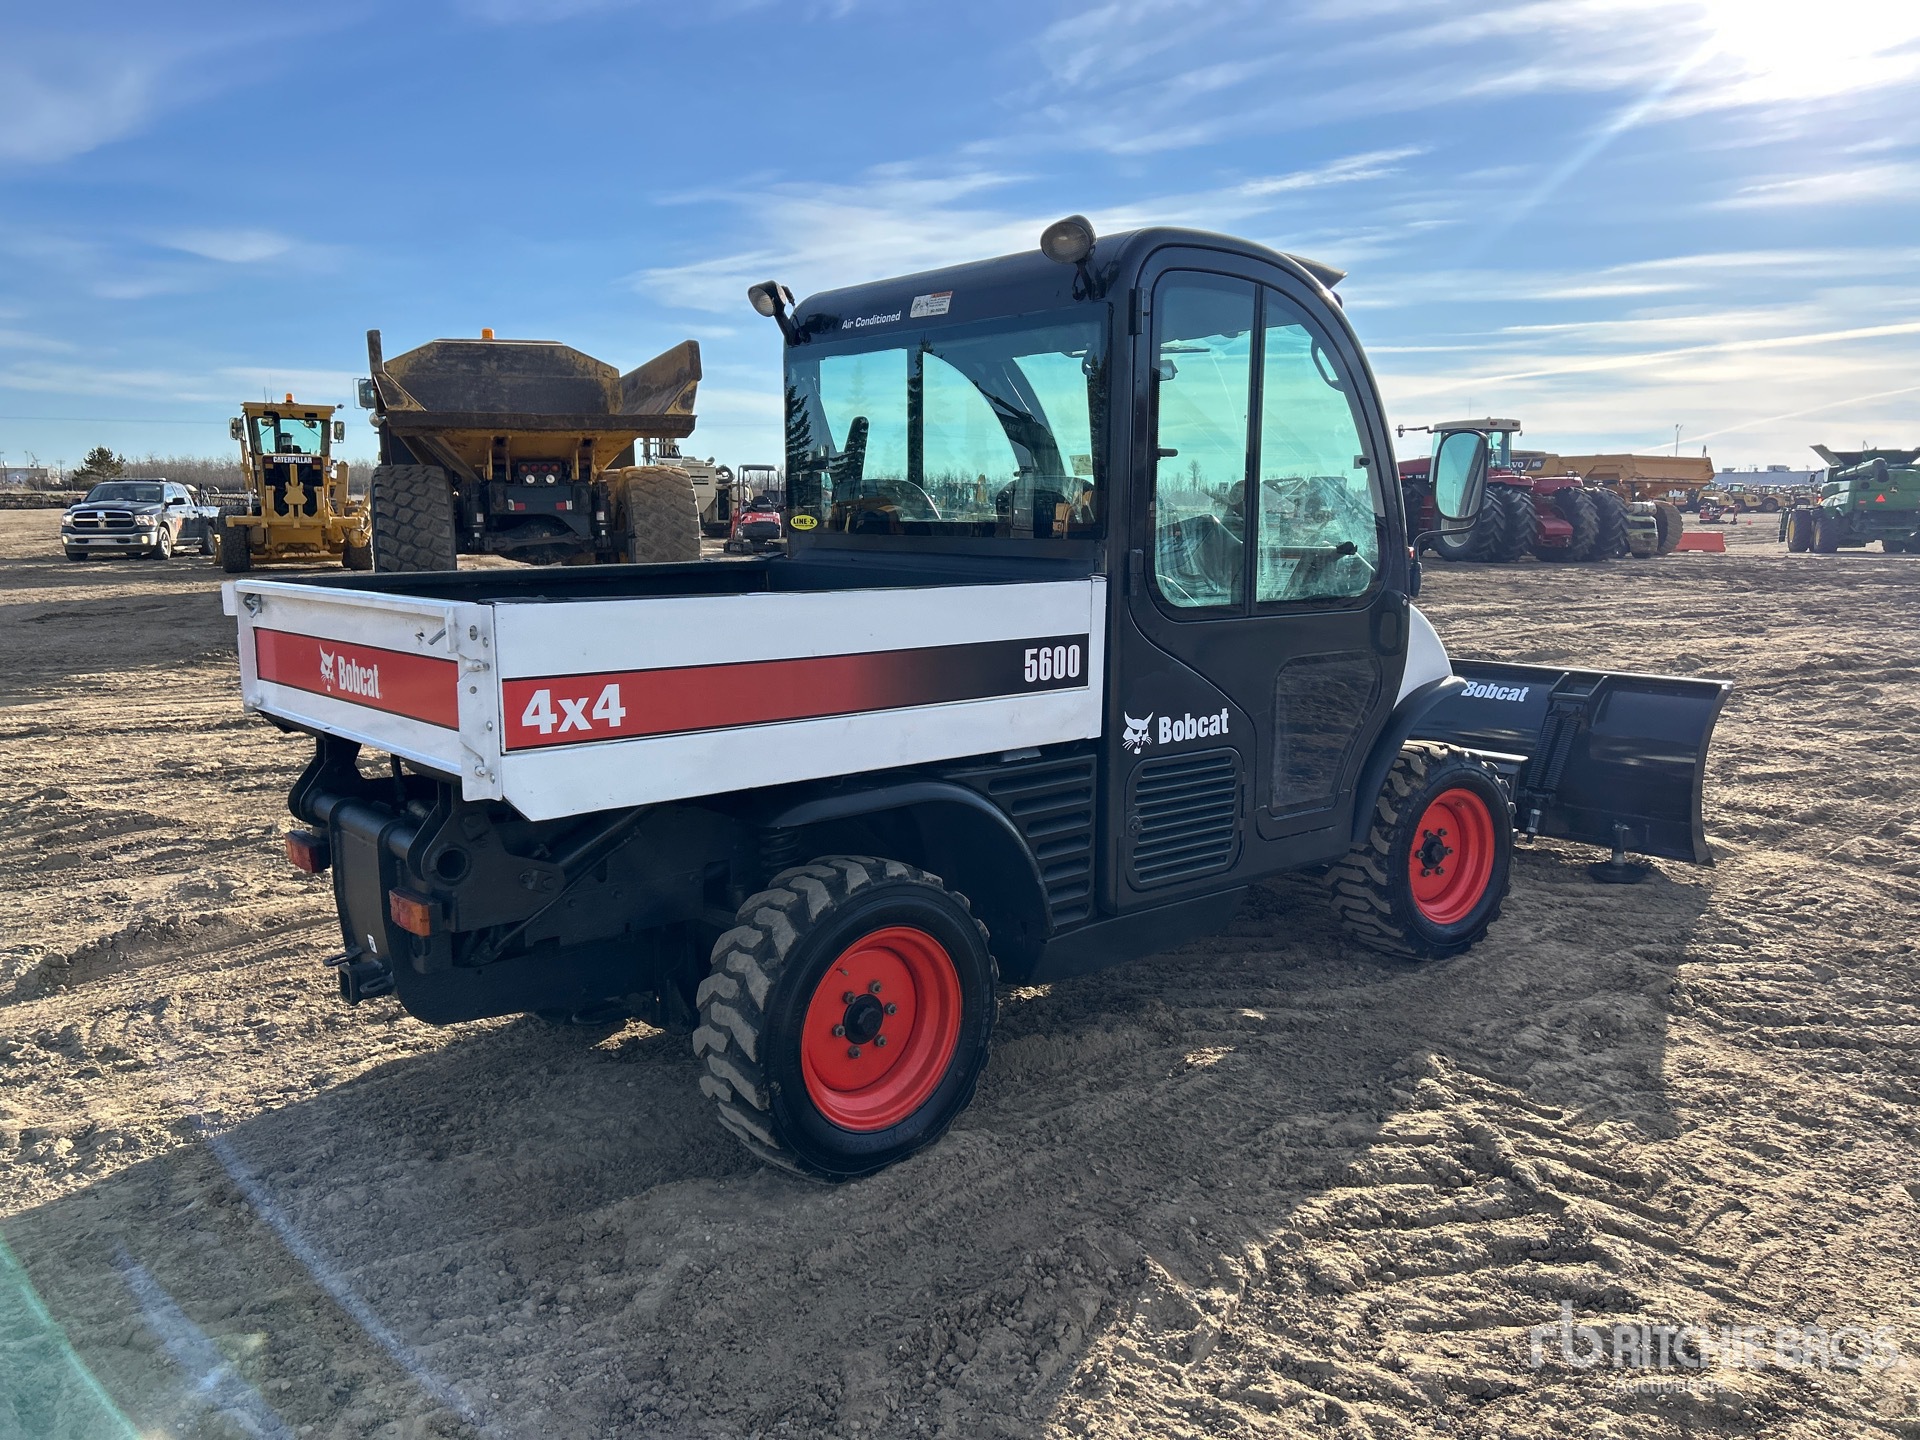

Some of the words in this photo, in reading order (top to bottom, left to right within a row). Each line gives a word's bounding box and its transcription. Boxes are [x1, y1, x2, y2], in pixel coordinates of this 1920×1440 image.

[841, 319, 853, 329] Air
[855, 310, 901, 327] Conditioned
[337, 655, 380, 699] Bobcat
[1024, 644, 1080, 683] 5600
[521, 683, 626, 734] 4x4
[1461, 681, 1529, 702] Bobcat
[1158, 707, 1229, 744] Bobcat
